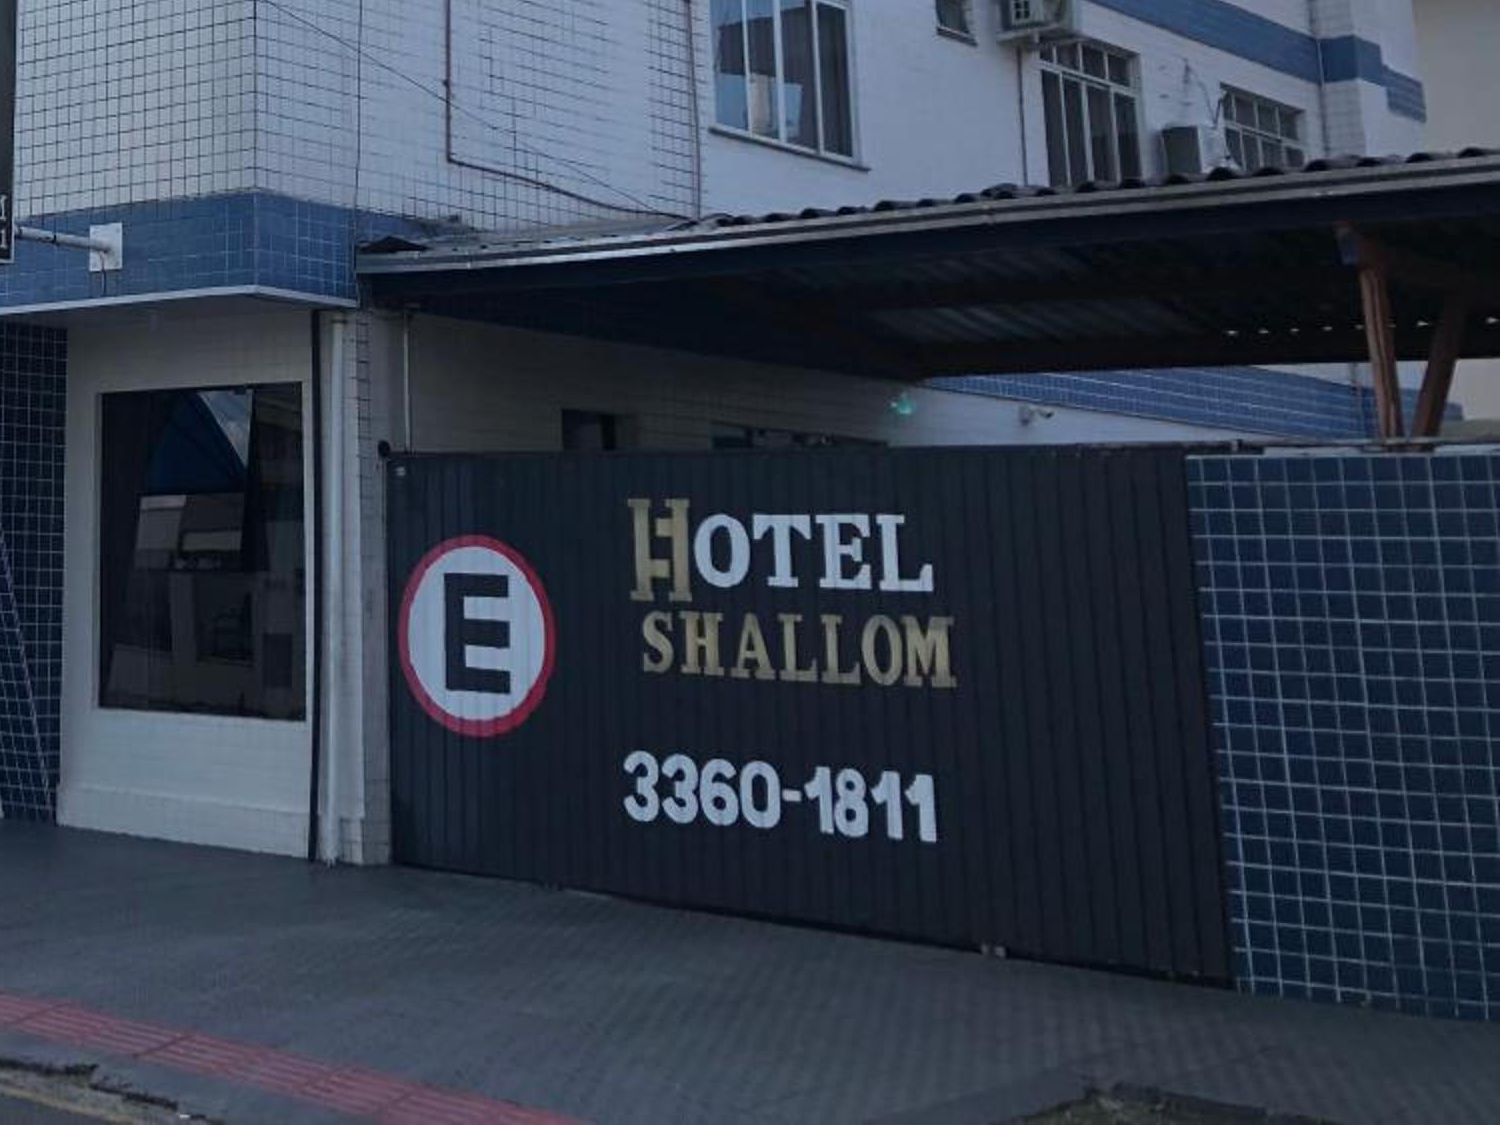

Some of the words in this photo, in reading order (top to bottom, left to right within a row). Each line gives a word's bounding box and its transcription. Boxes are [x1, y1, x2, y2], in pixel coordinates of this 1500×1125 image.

[627, 497, 934, 603] HOTEL
[443, 571, 512, 695] E
[642, 610, 958, 689] SHALLOM
[622, 750, 938, 843] 3360-1811
